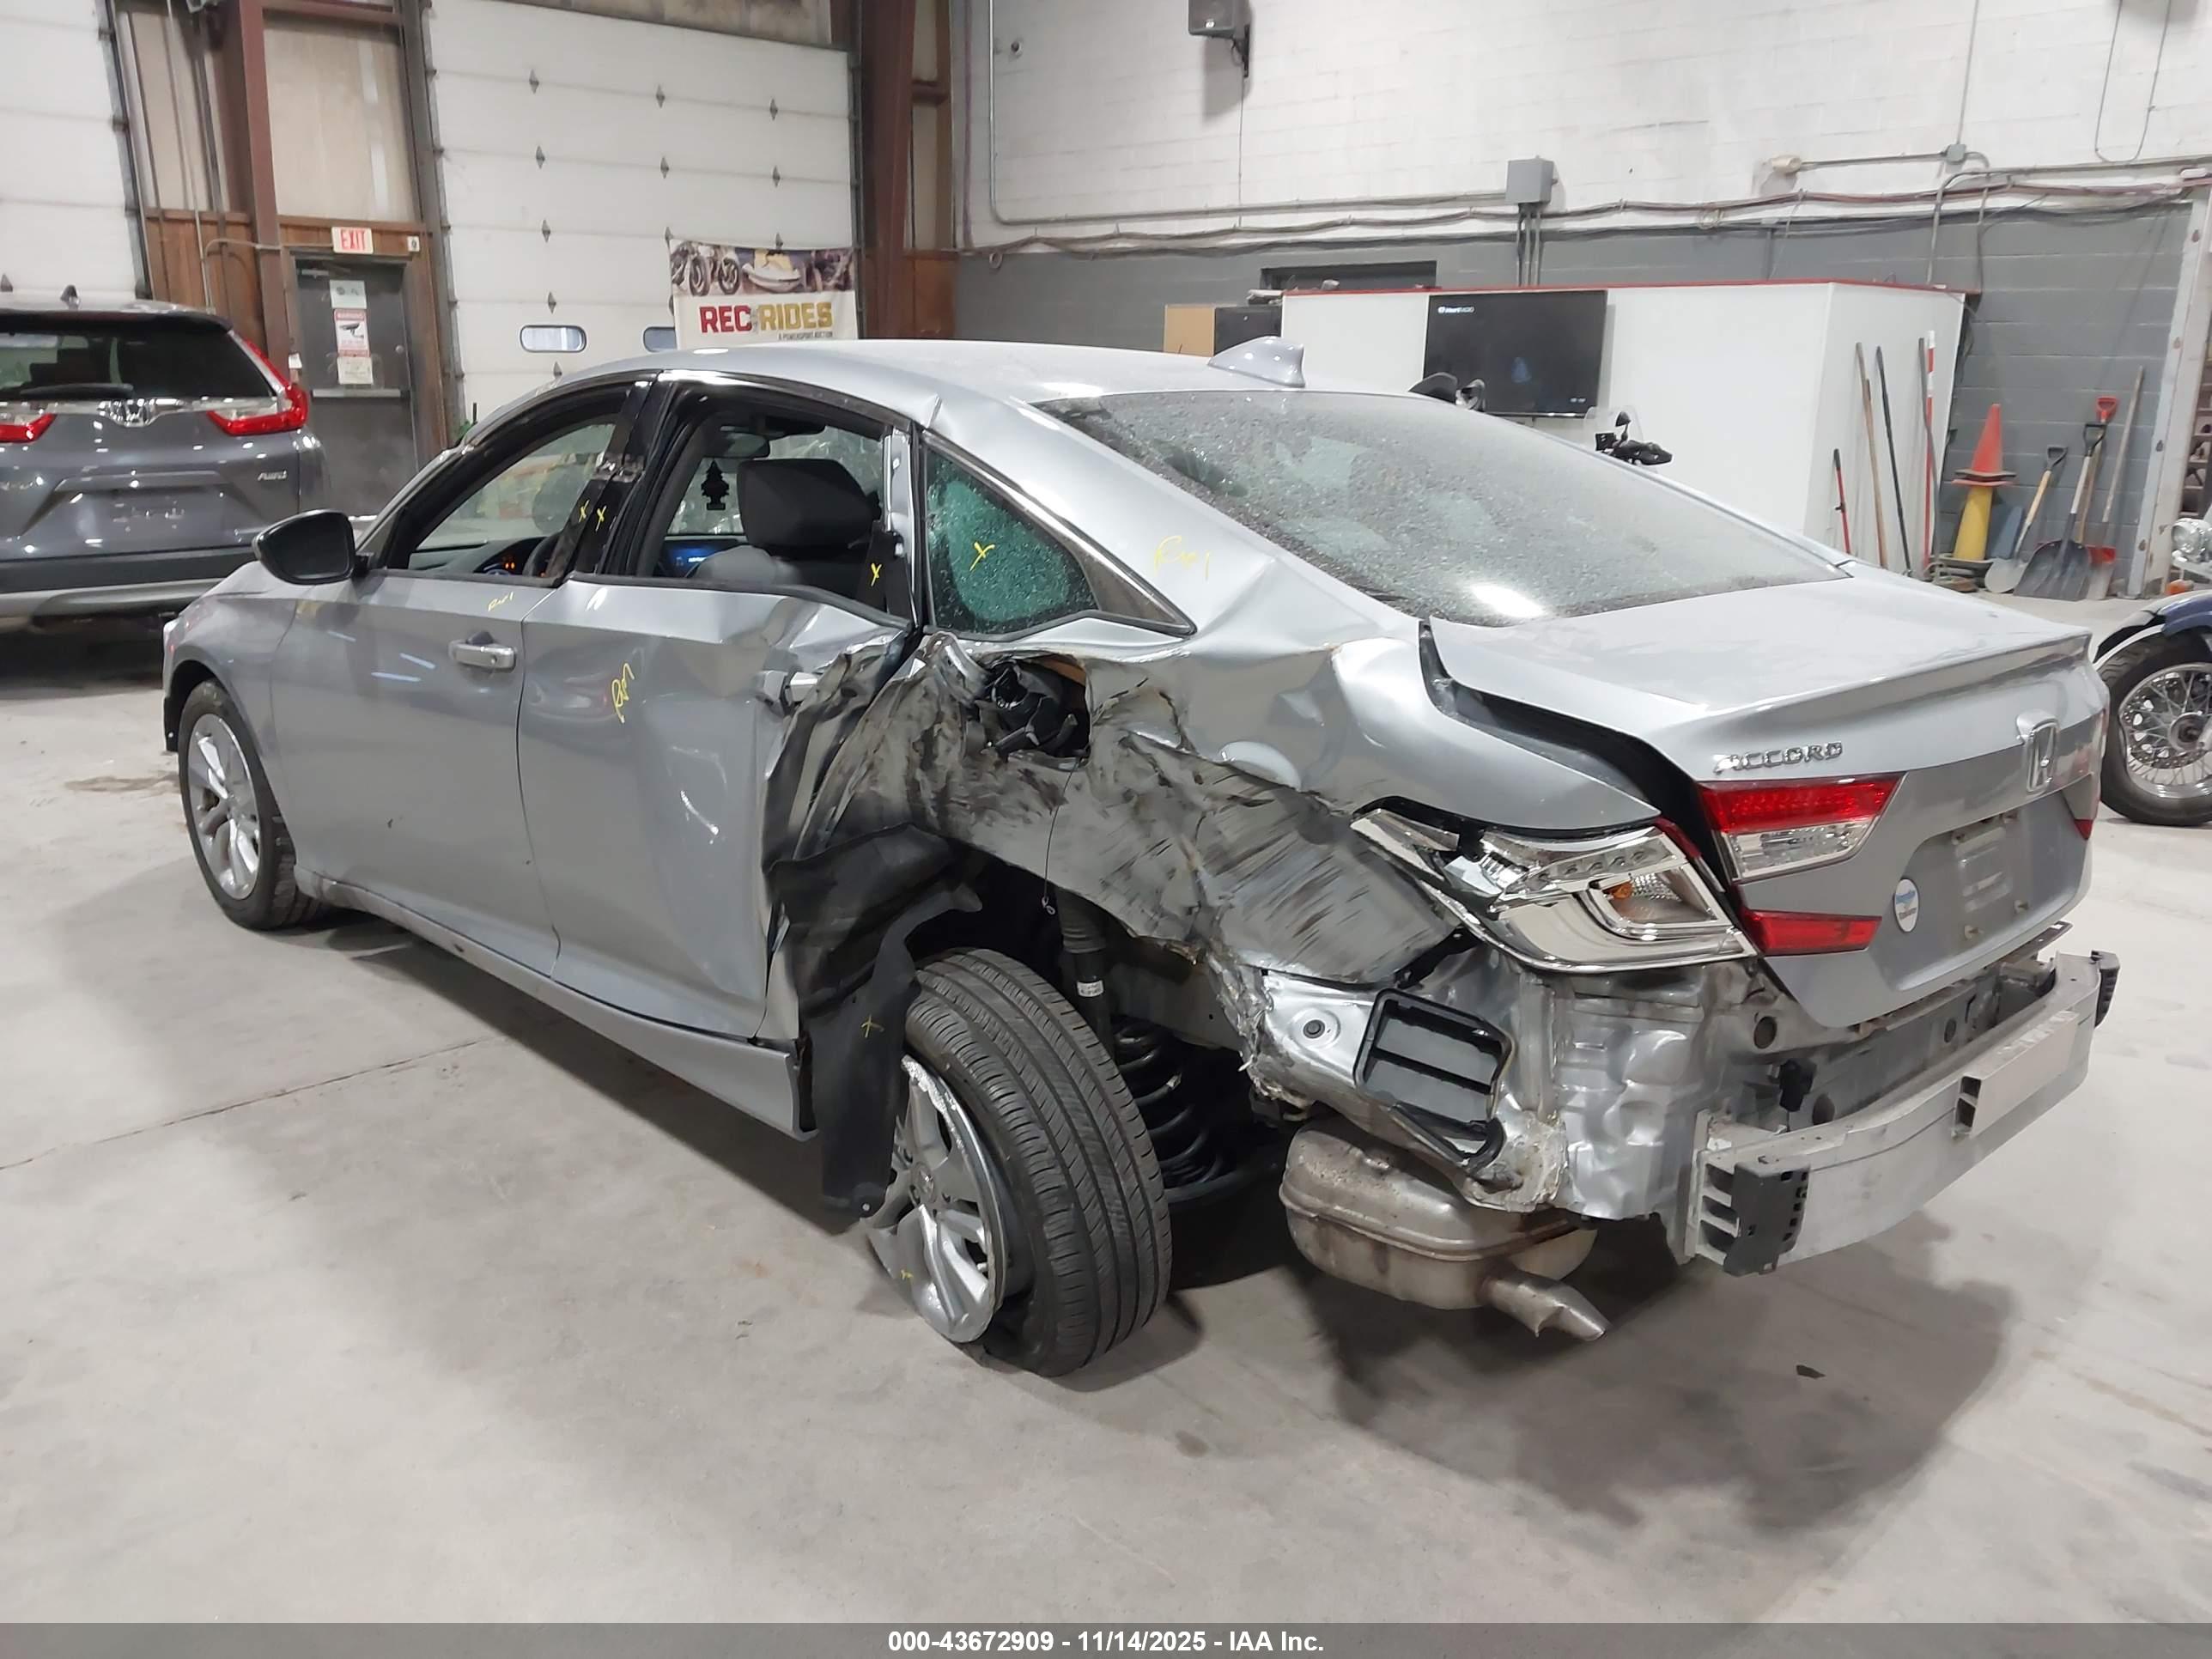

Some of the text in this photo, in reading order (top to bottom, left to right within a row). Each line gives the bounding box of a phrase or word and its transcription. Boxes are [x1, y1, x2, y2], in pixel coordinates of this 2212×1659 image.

[340, 228, 367, 251] EXIT
[699, 305, 753, 333] REC
[758, 301, 834, 331] RIDES
[1713, 741, 1843, 775] ACCORD
